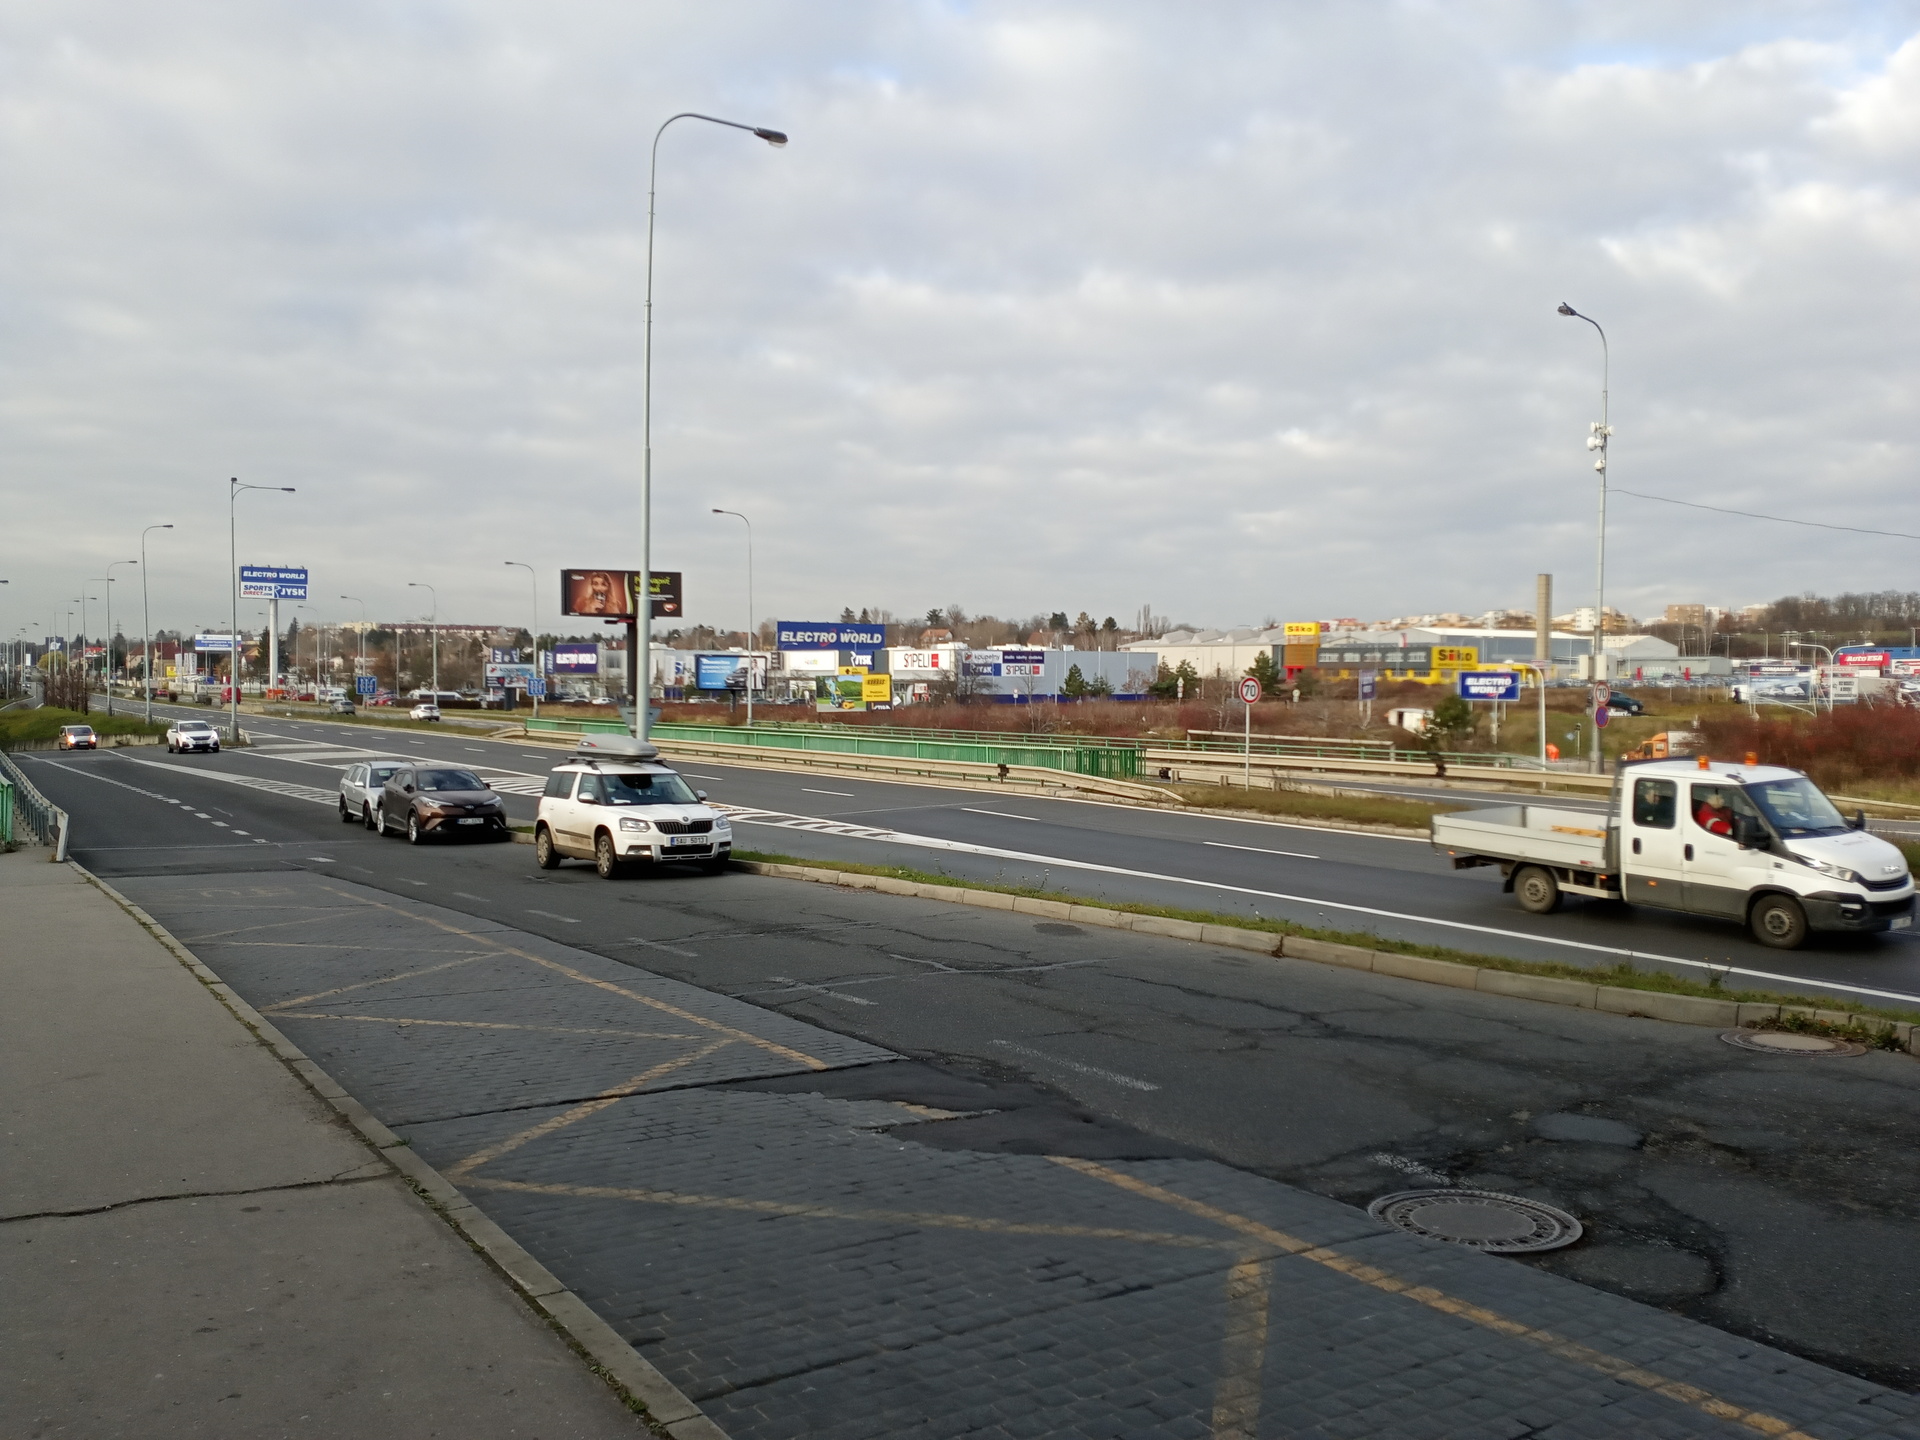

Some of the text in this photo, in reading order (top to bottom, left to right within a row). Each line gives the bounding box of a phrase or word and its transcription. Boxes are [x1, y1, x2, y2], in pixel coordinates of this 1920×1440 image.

[280, 588, 305, 596] JYSK
[780, 631, 882, 643] ELECTRO WORLD
[1465, 677, 1512, 686] ELECTRO
[1244, 685, 1256, 697] 70
[1469, 686, 1506, 694] WORLD
[1598, 688, 1607, 698] 70
